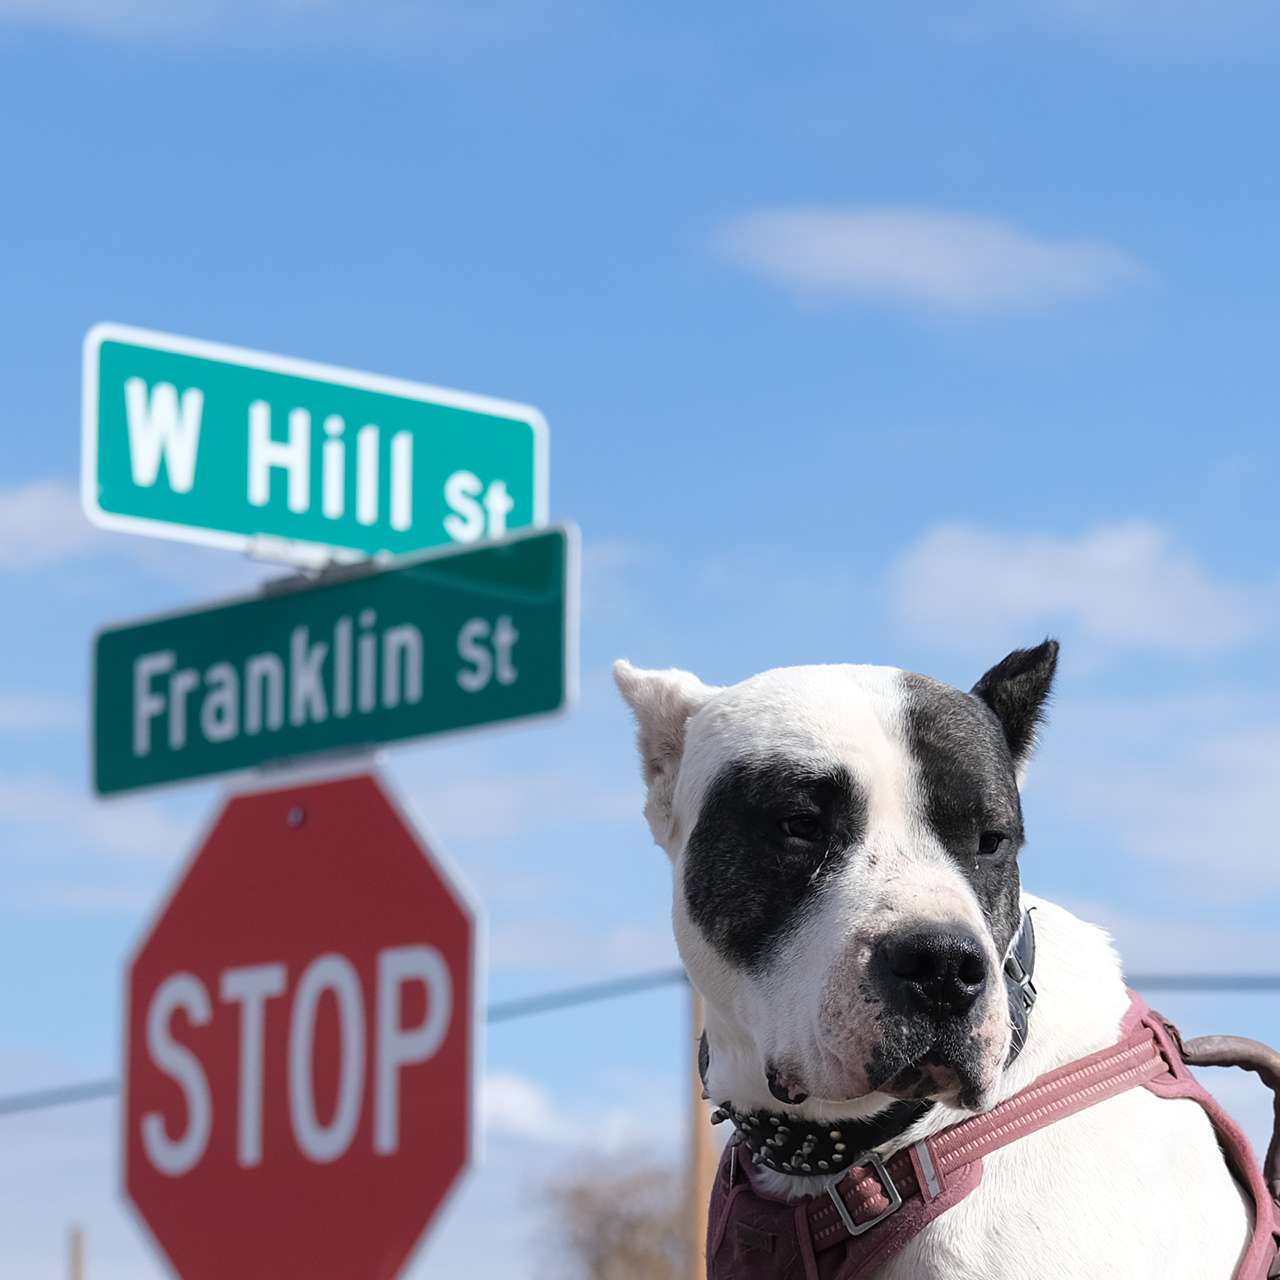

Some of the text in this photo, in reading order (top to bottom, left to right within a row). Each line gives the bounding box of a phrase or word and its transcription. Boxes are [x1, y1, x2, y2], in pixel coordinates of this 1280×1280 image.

[124, 375, 515, 543] W Hill St
[132, 608, 519, 757] Franklin St
[140, 943, 455, 1178] STOP
